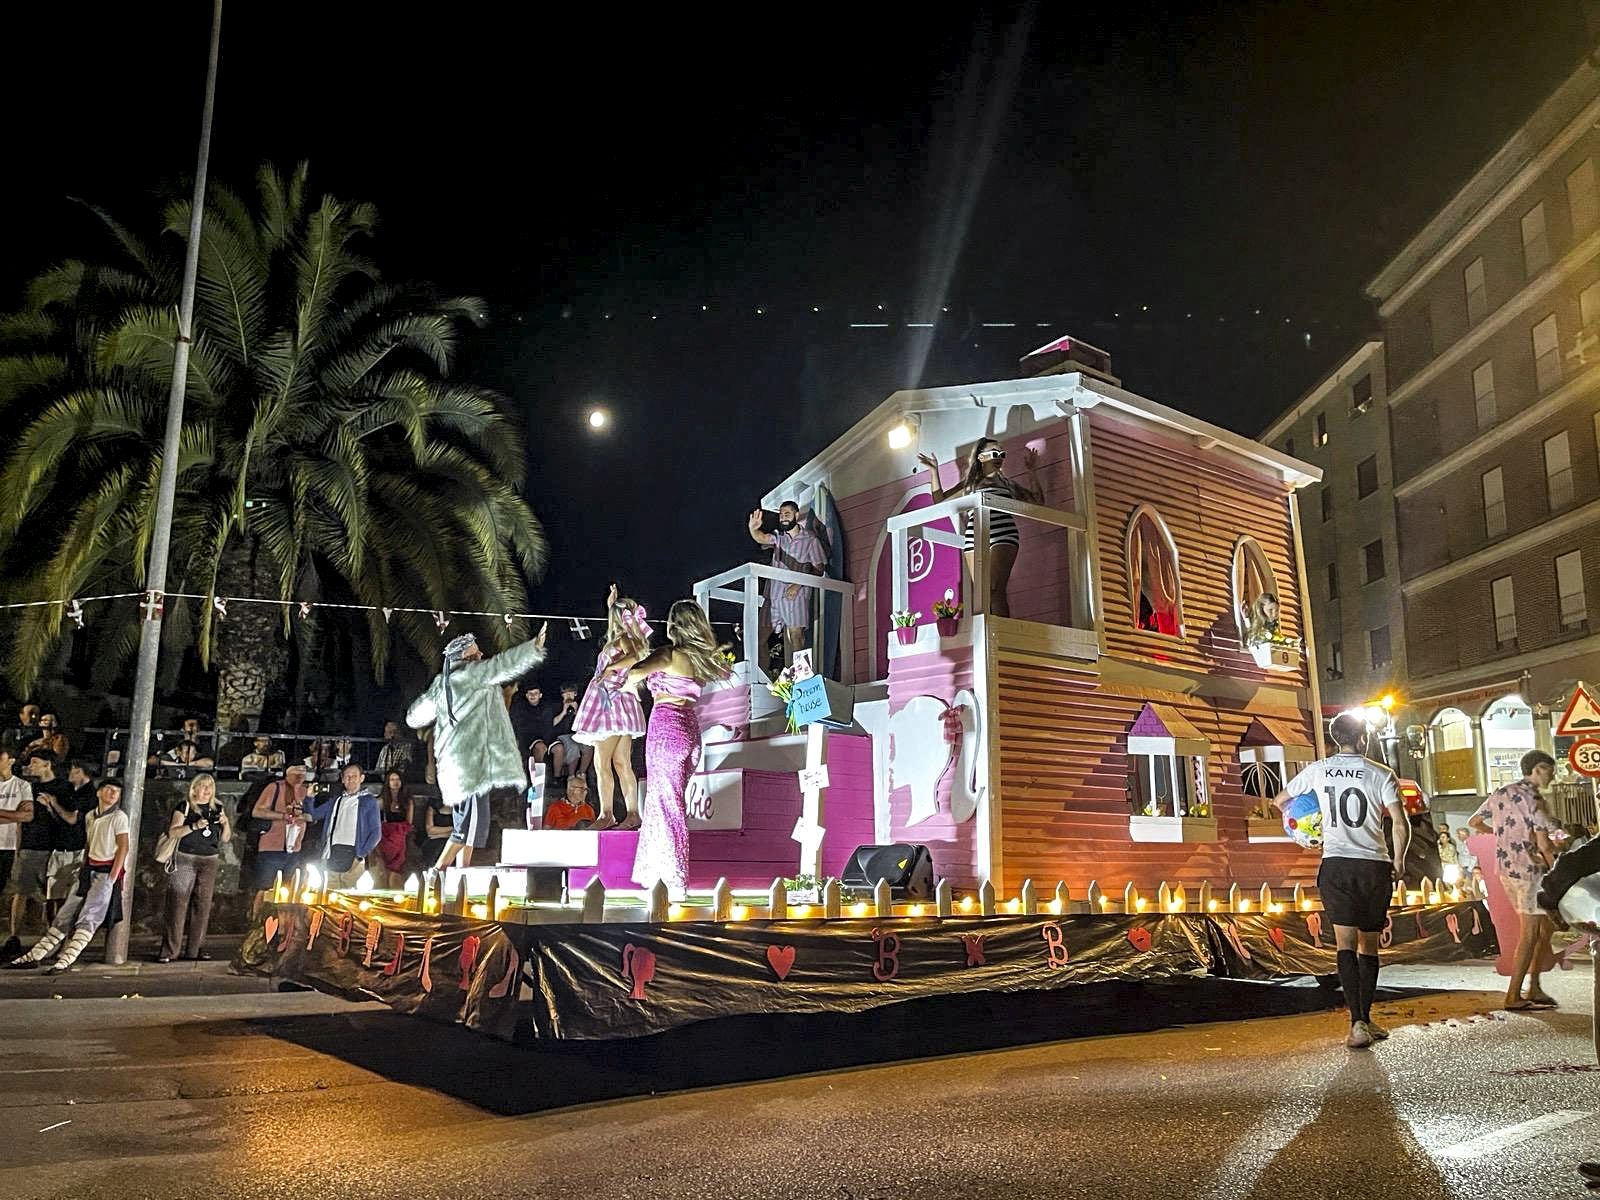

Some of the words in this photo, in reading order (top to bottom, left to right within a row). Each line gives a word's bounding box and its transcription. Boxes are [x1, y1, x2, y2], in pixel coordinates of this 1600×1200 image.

[908, 538, 924, 573] B
[795, 684, 821, 701] Dream
[1325, 769, 1365, 779] KANE
[1579, 750, 1600, 764] 30
[685, 782, 715, 820] bie
[1324, 786, 1368, 828] 10
[1042, 921, 1069, 970] B
